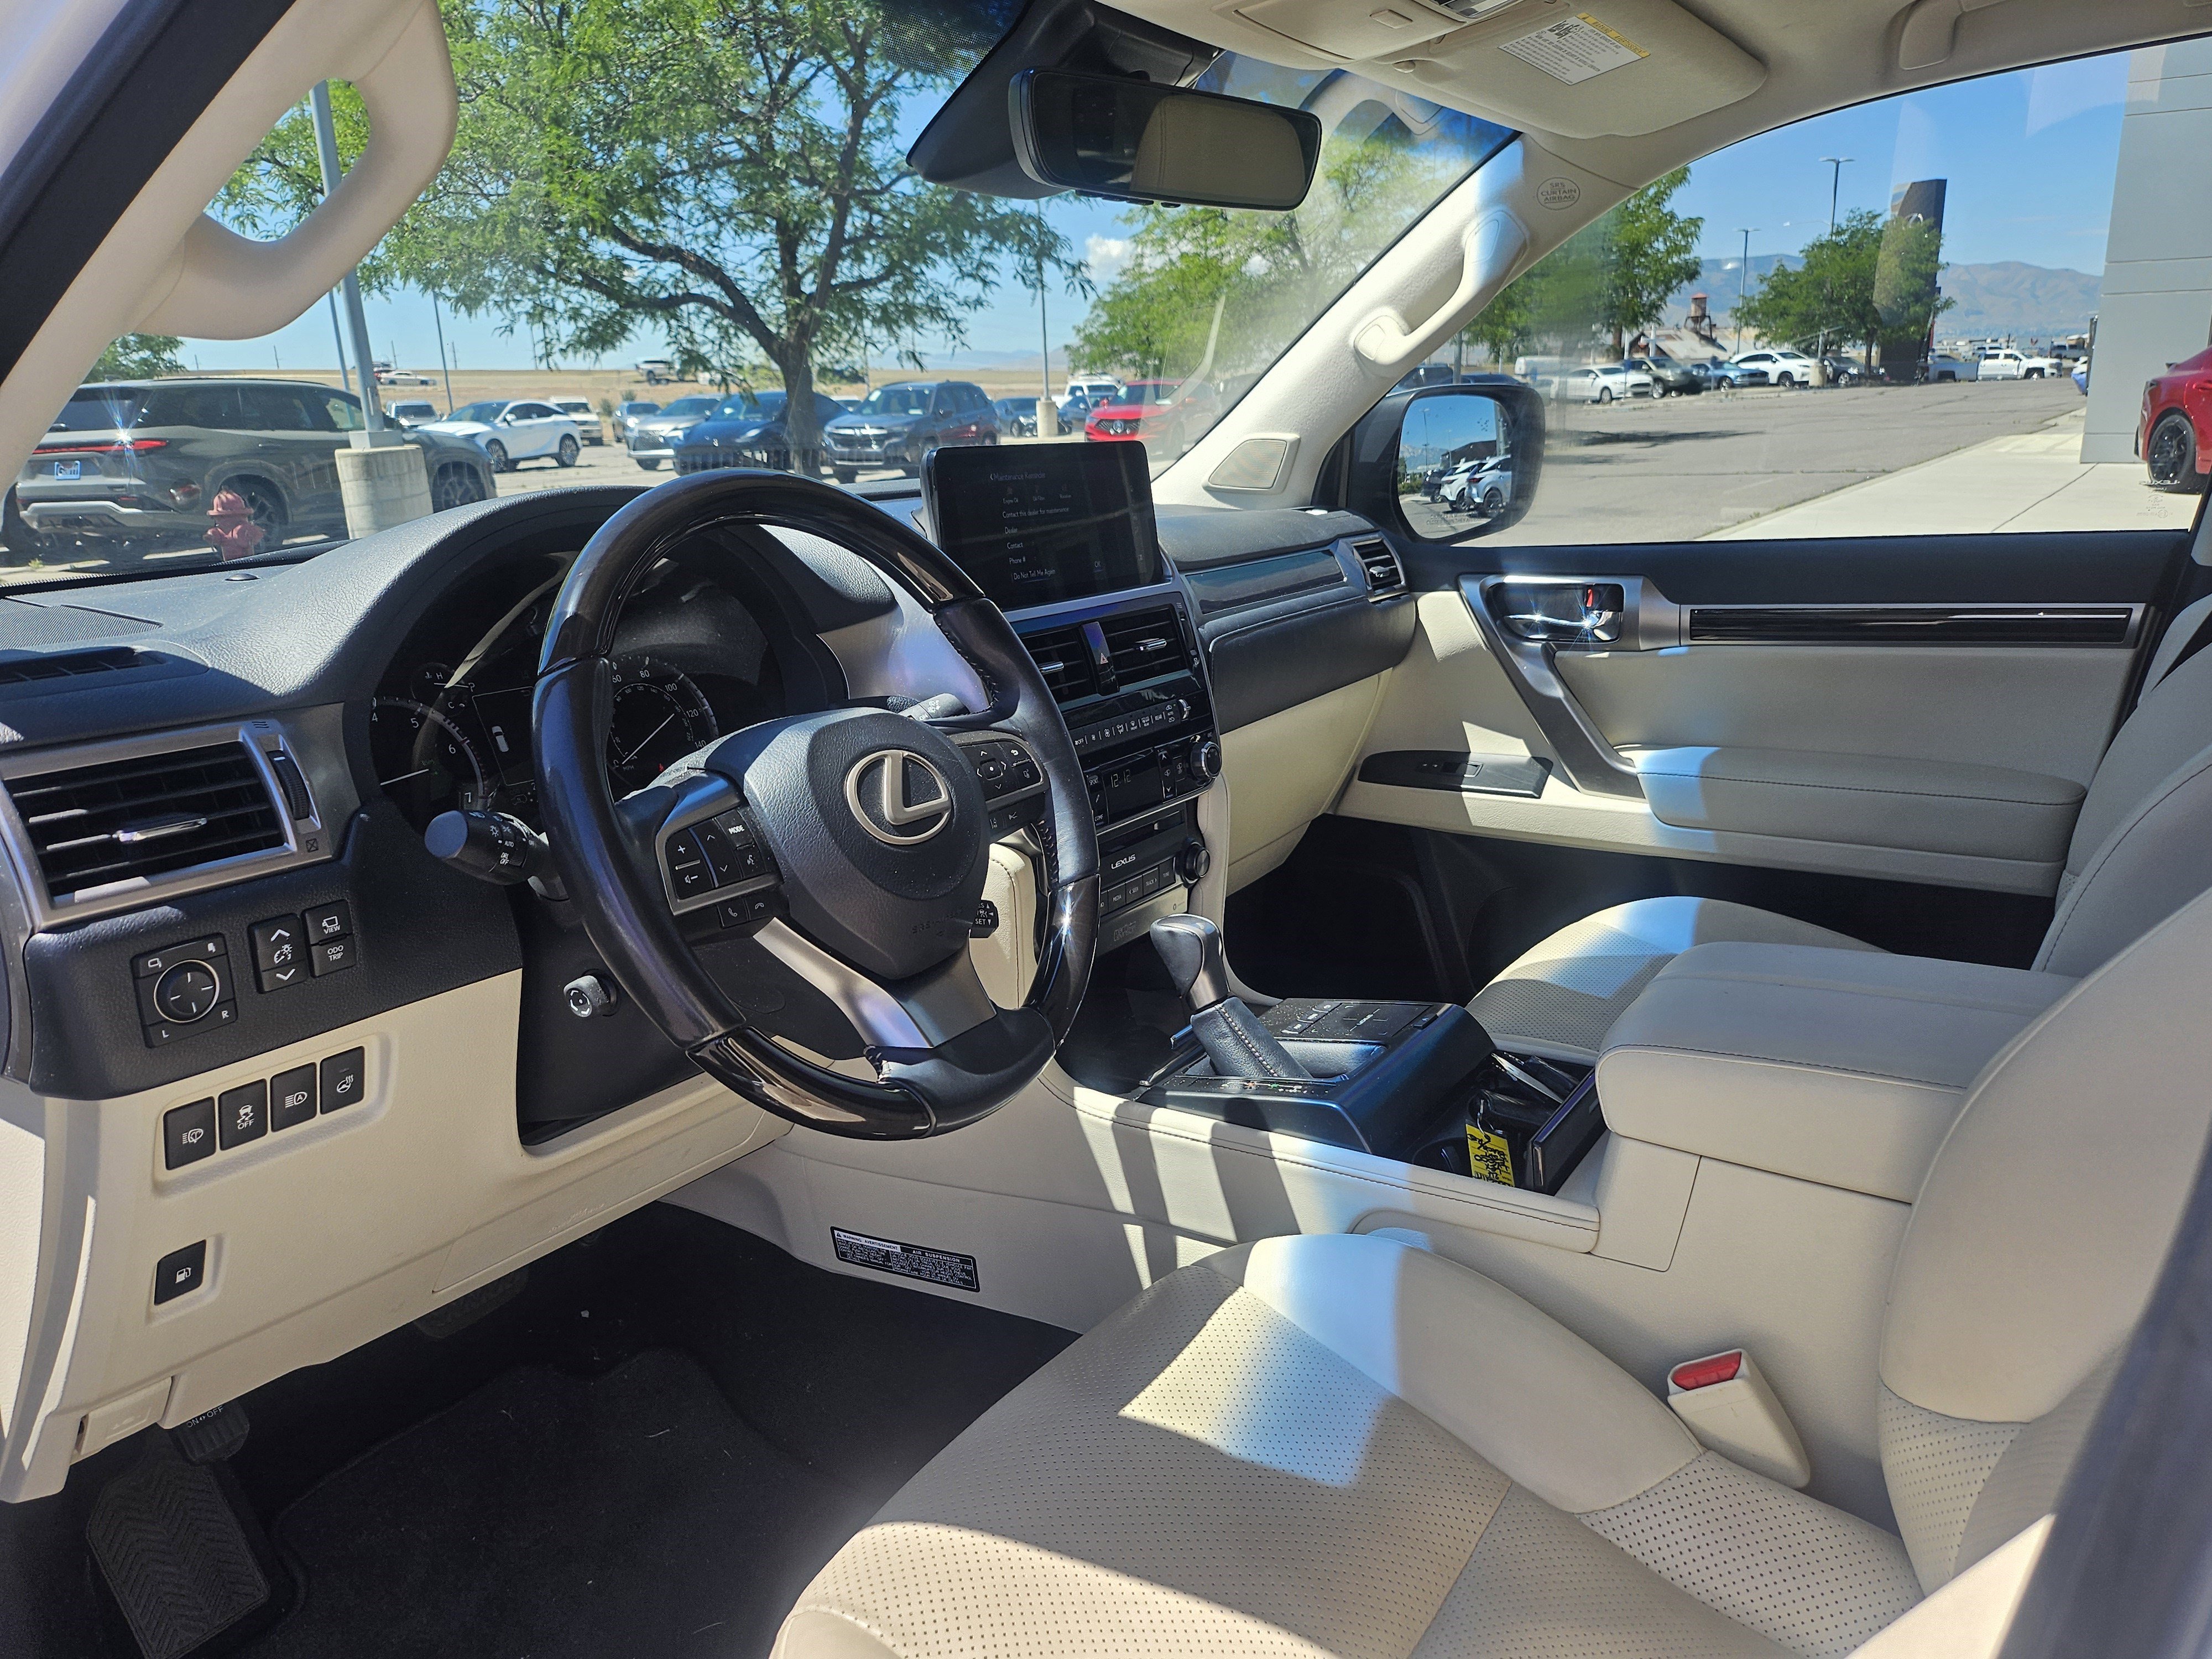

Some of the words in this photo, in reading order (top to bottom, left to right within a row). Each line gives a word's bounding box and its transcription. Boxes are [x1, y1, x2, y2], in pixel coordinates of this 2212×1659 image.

[1541, 188, 1576, 196] CURTAIN
[1044, 568, 1056, 577] Again
[612, 674, 622, 683] 60
[639, 669, 650, 678] 80
[665, 683, 677, 692] 100
[372, 712, 378, 722] 4
[686, 708, 699, 718] 120
[410, 717, 419, 728] 5
[448, 744, 456, 754] 6
[695, 740, 707, 749] 140
[1089, 778, 1098, 786] SPORT
[1110, 769, 1131, 788] 12:12
[464, 792, 472, 802] 7
[728, 825, 745, 834] MODE
[1111, 854, 1136, 869] LEXUS
[324, 925, 341, 935] VIEW
[327, 945, 344, 955] ODO
[328, 952, 343, 962] TRIP
[221, 1010, 229, 1019] R
[161, 1029, 169, 1039] L
[237, 1118, 255, 1130] OFF
[842, 1234, 862, 1242] WARNING
[864, 1239, 898, 1250] AVERTISSEMENT
[925, 1252, 961, 1263] SUSPENSION
[186, 1417, 199, 1428] ON
[207, 1405, 223, 1417] OFF
